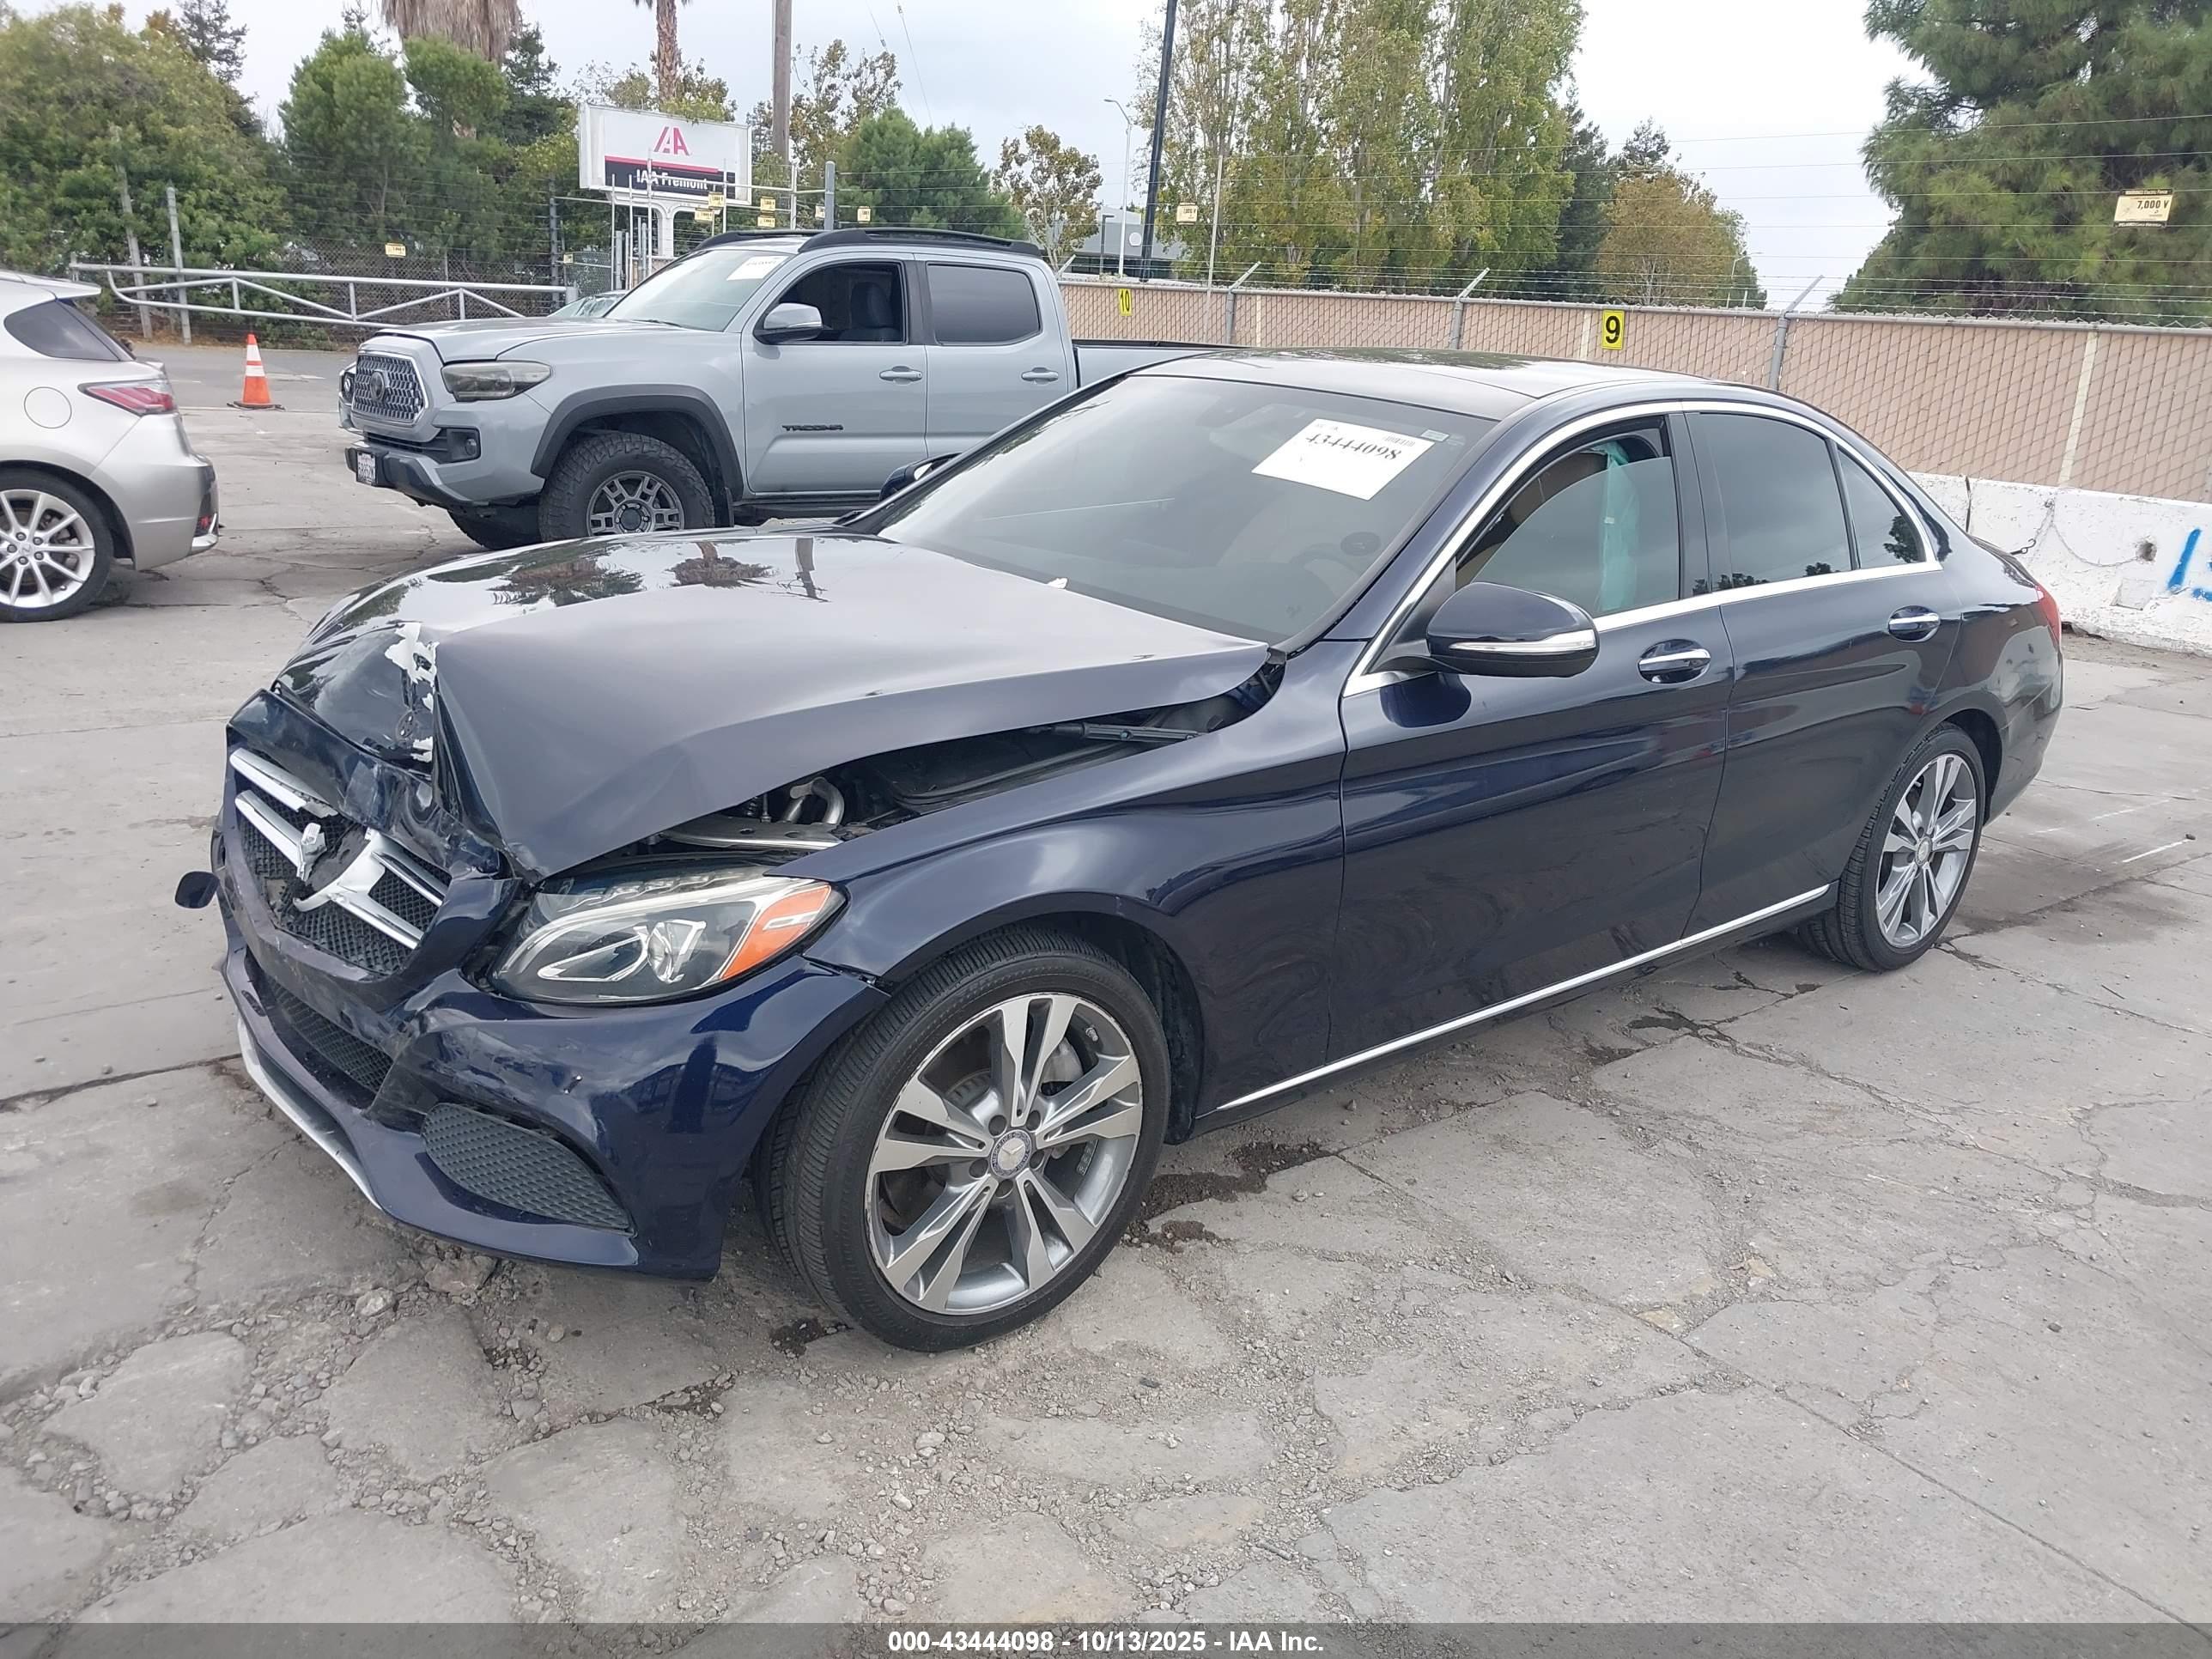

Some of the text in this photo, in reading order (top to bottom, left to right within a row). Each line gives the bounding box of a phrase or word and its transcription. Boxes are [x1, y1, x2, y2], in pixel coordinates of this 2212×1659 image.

[661, 172, 708, 190] Fremont
[2136, 199, 2170, 210] 7,000 V
[1120, 289, 1130, 313] 10
[1605, 315, 1621, 344] 9
[1305, 433, 1402, 460] 43444098
